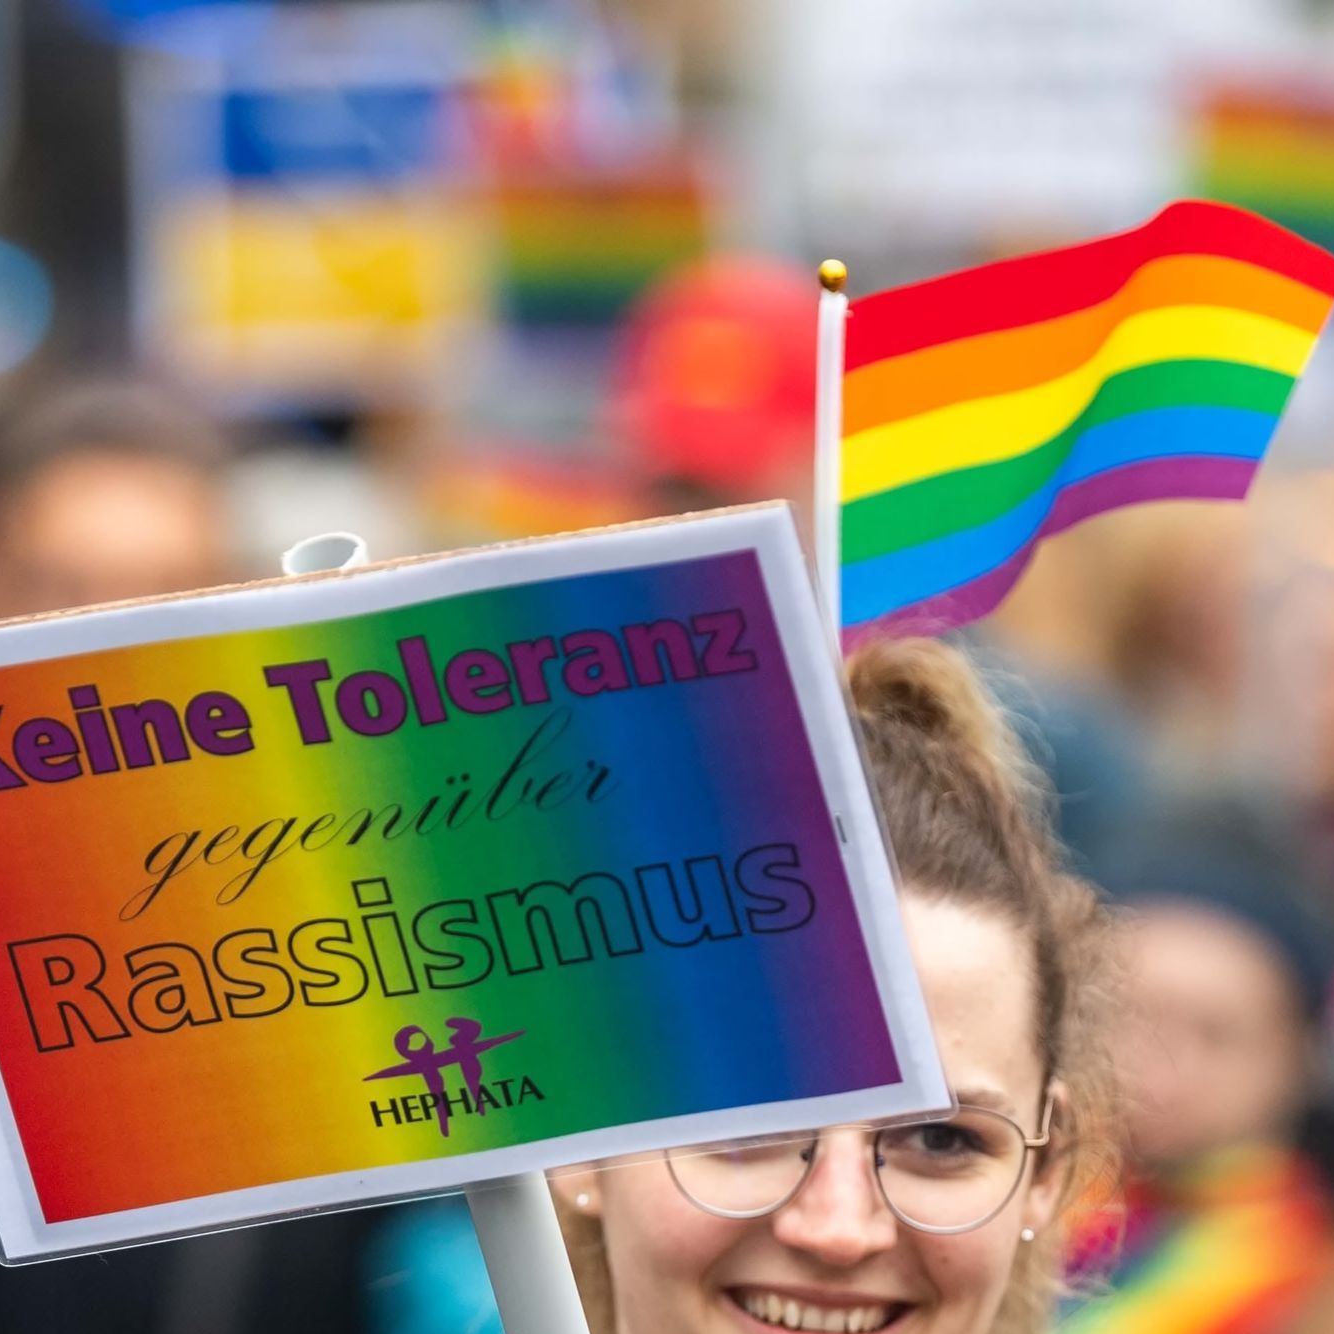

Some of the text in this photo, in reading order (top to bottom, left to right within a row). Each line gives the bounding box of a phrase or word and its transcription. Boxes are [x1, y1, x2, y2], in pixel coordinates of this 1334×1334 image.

[262, 608, 758, 746] Toleranz
[119, 705, 620, 921] gegenüber
[7, 843, 816, 1053] Rassismus
[370, 1075, 546, 1127] HEPHATA
